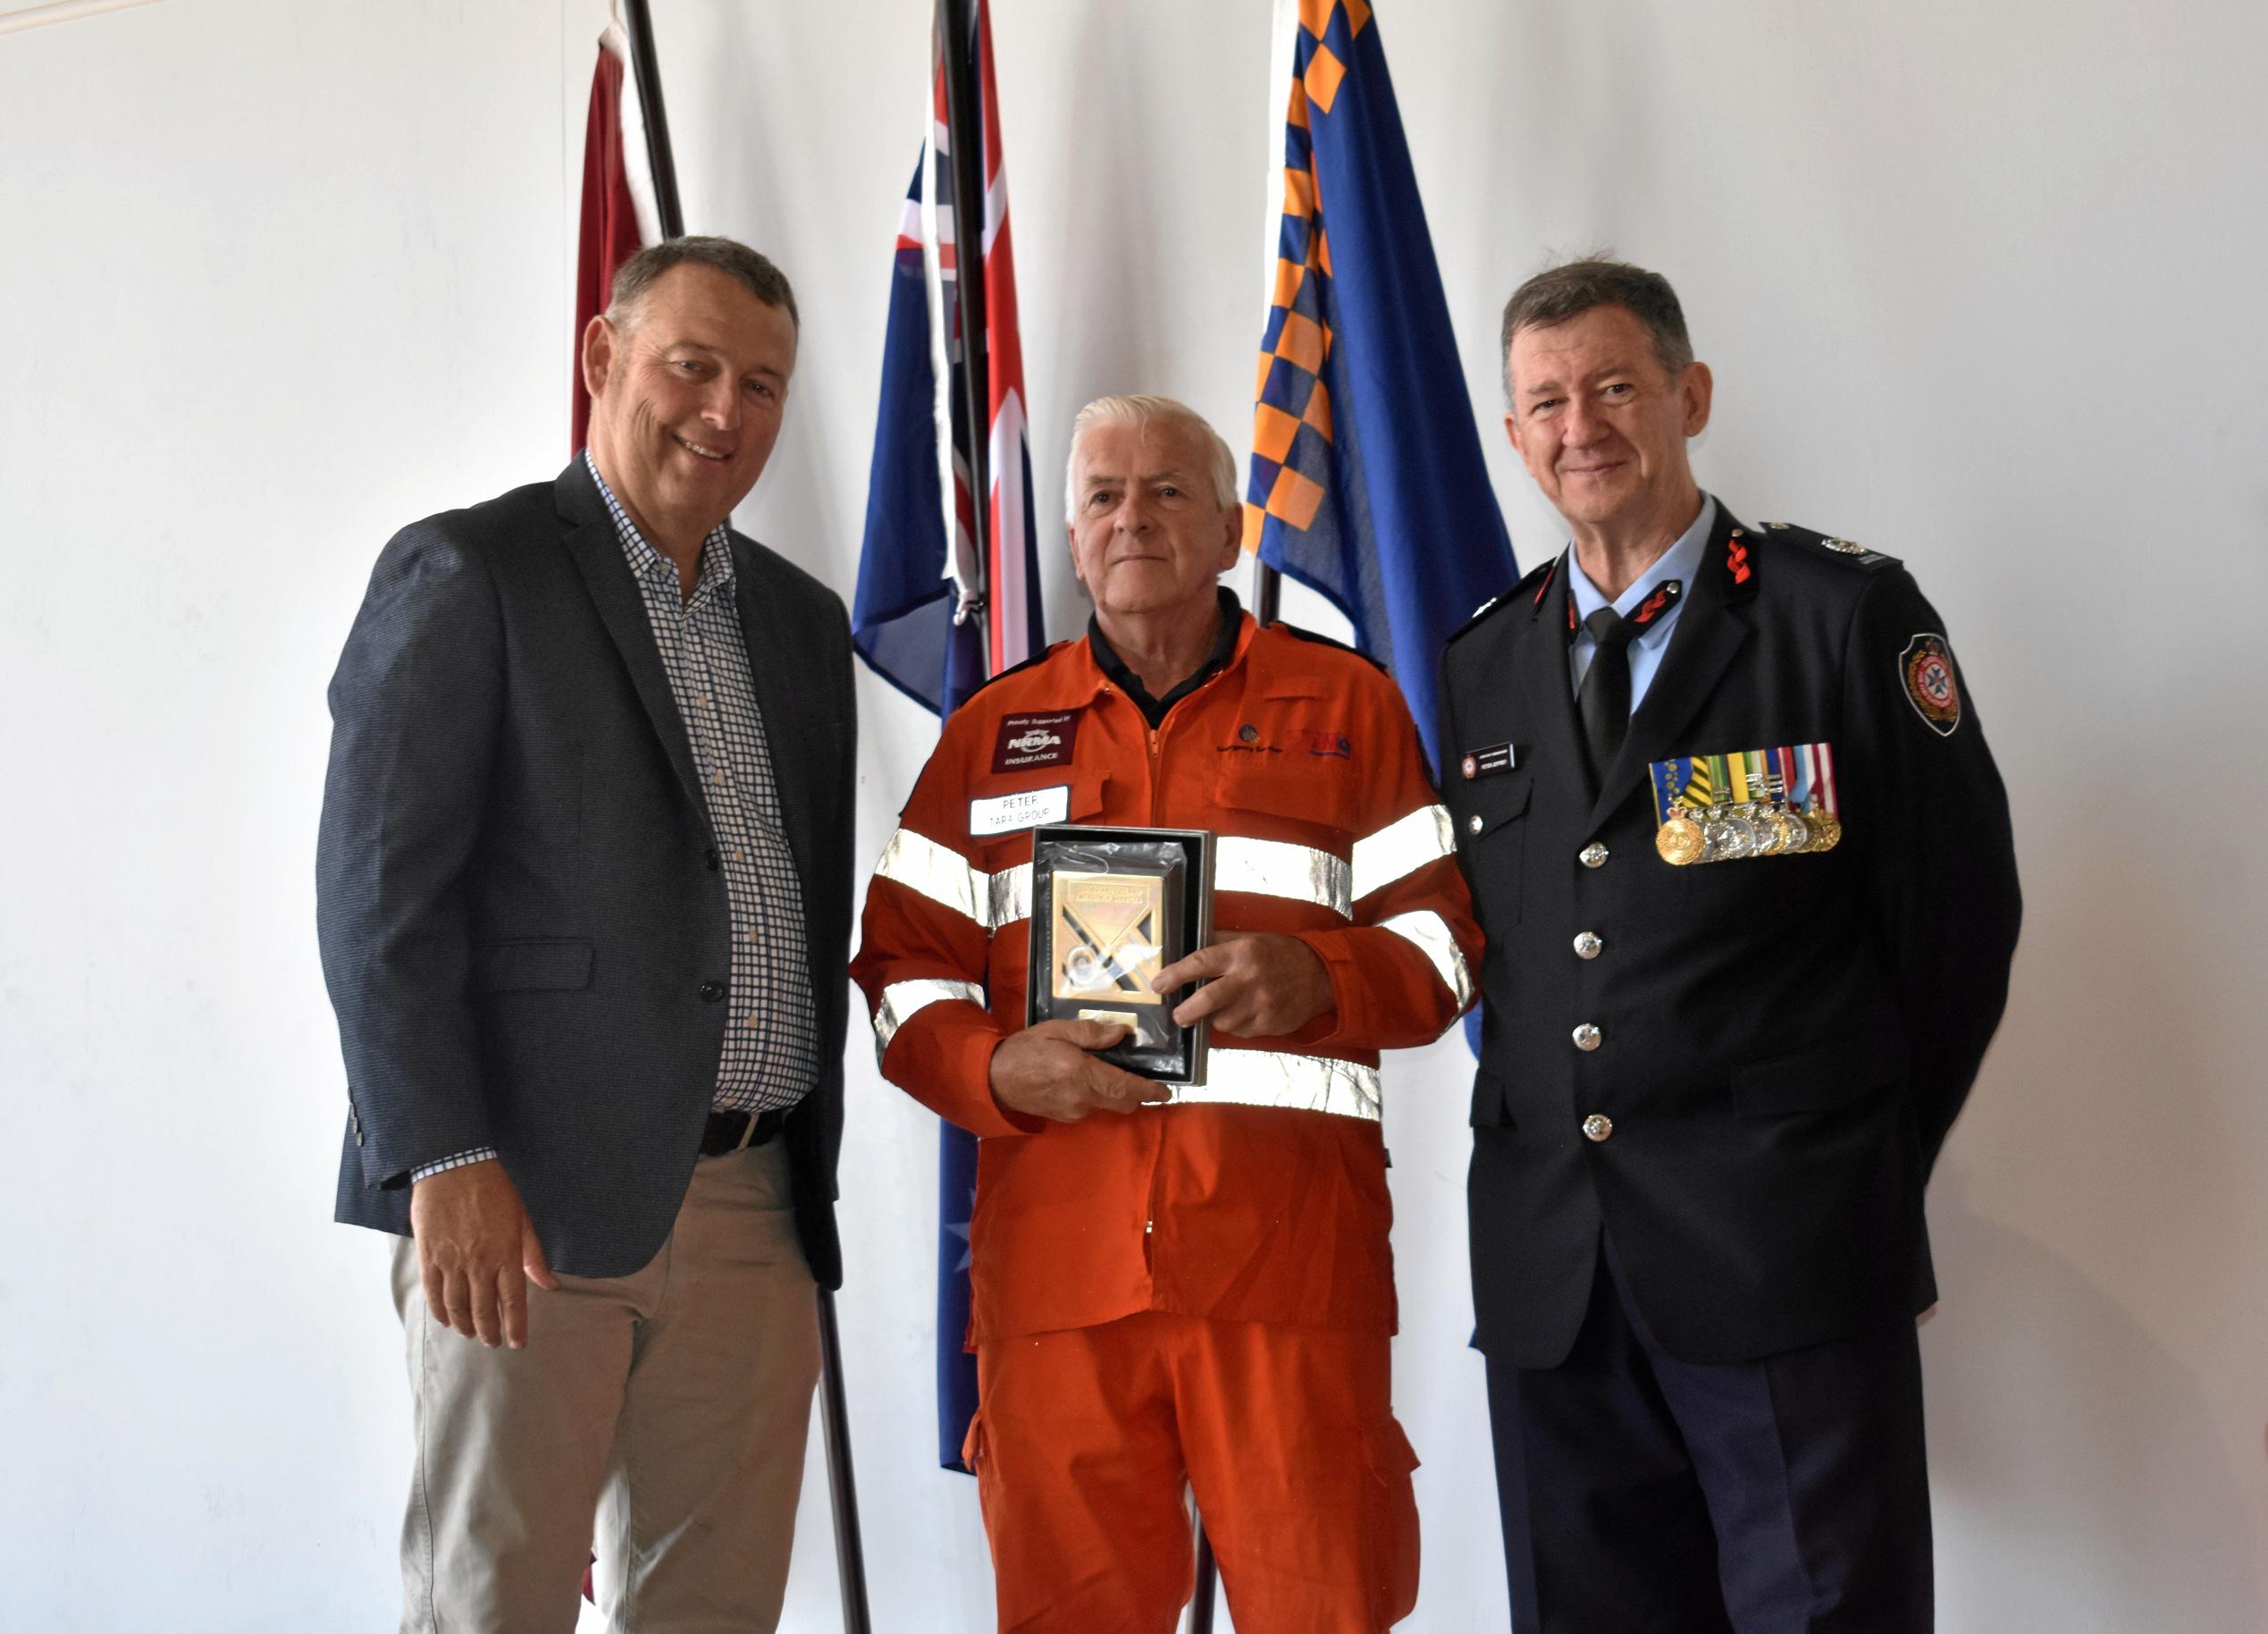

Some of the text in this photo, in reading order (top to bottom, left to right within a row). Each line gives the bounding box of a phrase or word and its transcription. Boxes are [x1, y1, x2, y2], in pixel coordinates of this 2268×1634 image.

[1008, 735, 1061, 749] NRMA
[1004, 752, 1059, 765] INSURANCE
[1003, 795, 1038, 809] PETER
[1018, 807, 1050, 822] GROUP
